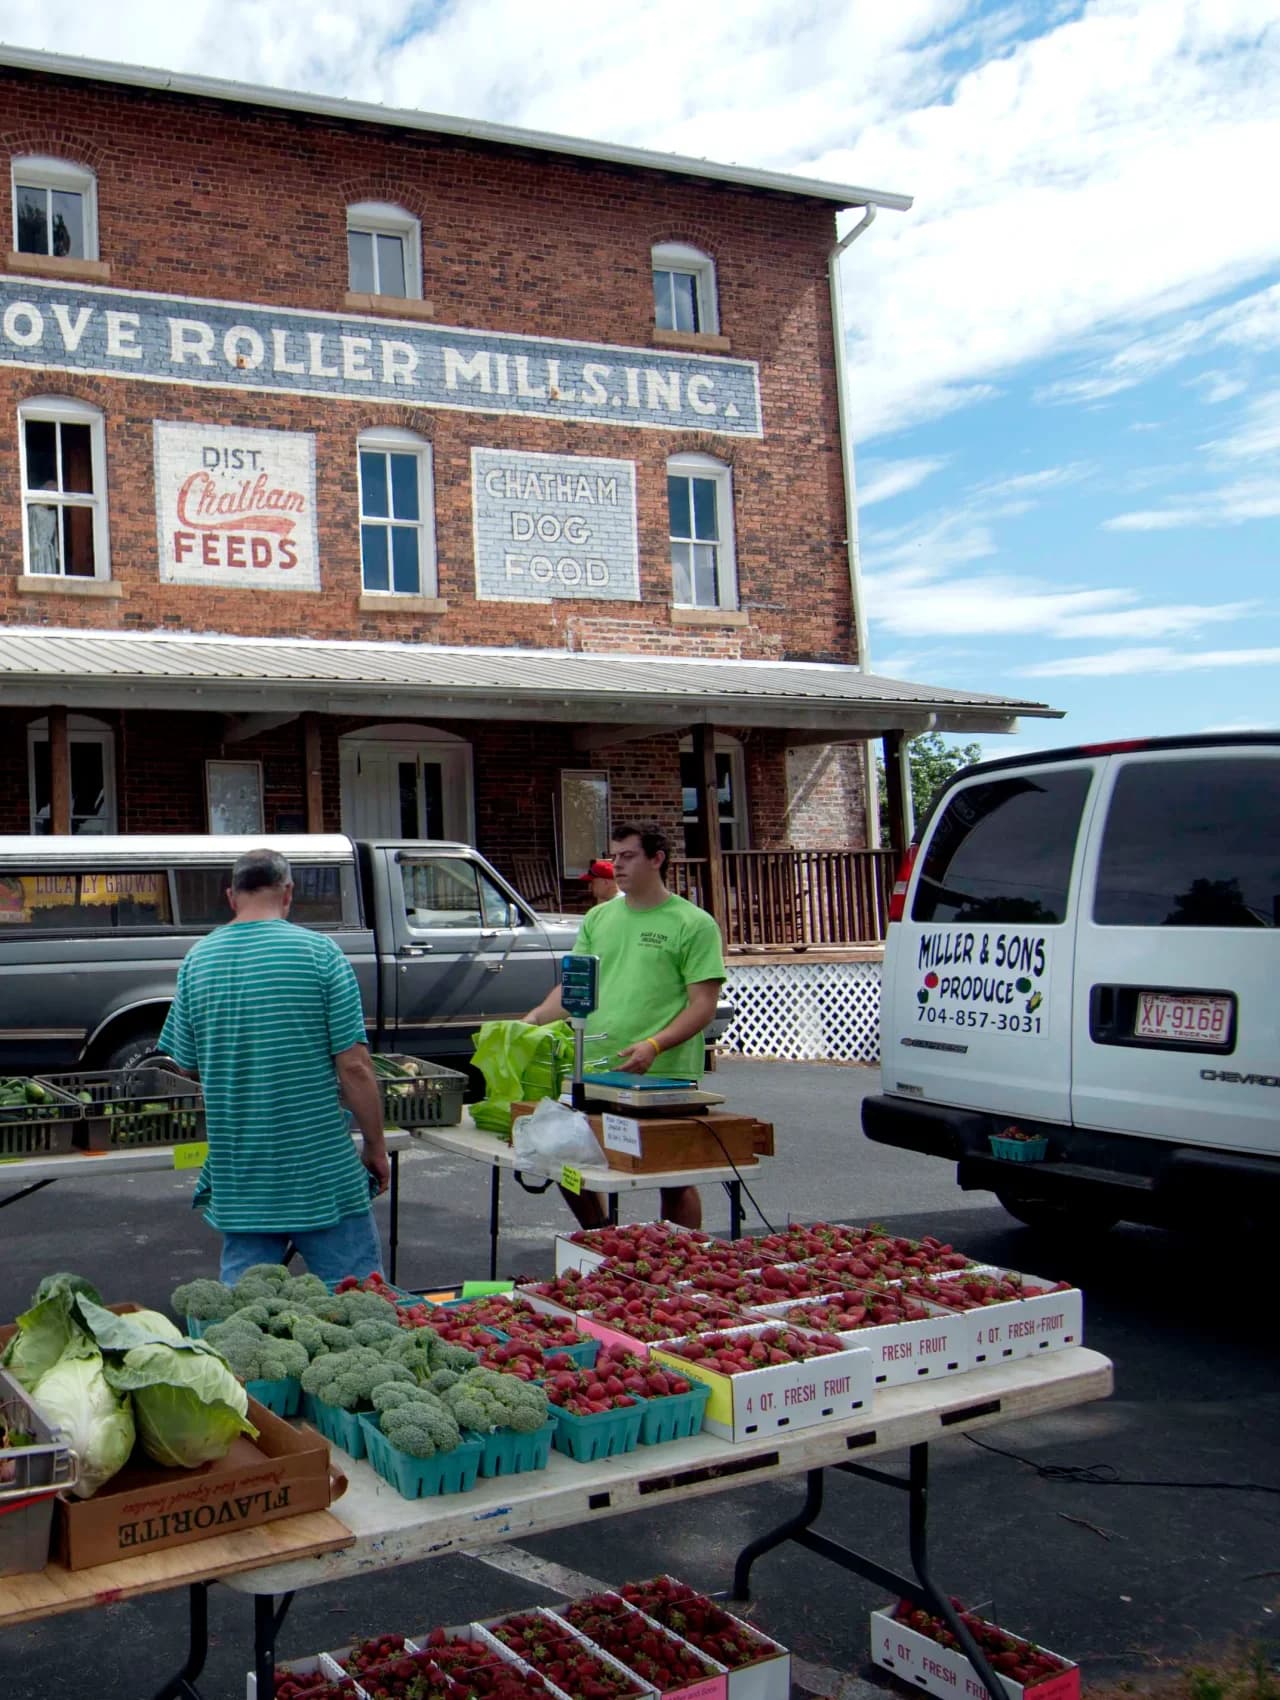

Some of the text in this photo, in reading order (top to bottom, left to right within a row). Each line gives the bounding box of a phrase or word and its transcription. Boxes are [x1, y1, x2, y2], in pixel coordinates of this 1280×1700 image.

[169, 317, 419, 387] ROLLER
[202, 446, 265, 471] DIST.
[177, 471, 305, 531] Chatham
[484, 469, 618, 506] CHATHAM
[511, 511, 593, 545] DOG
[174, 530, 298, 570] FEEDS
[504, 552, 609, 587] FOOD
[918, 933, 1045, 977] MILLER & SONS
[940, 976, 1014, 1004] PRODUCE
[917, 1006, 1041, 1034] 704-857-3031
[1141, 1004, 1225, 1031] XV-9168
[1200, 1069, 1280, 1087] CHEVRO
[976, 1314, 1065, 1344] 4 QT. FRESH FRUIT
[882, 1336, 948, 1361] FRESH FRUIT
[746, 1376, 851, 1414] 4 QT. FRESH FRUIT
[118, 1486, 292, 1548] FLAVORITE
[883, 1638, 890, 1650] 4
[922, 1657, 957, 1686] FRESH
